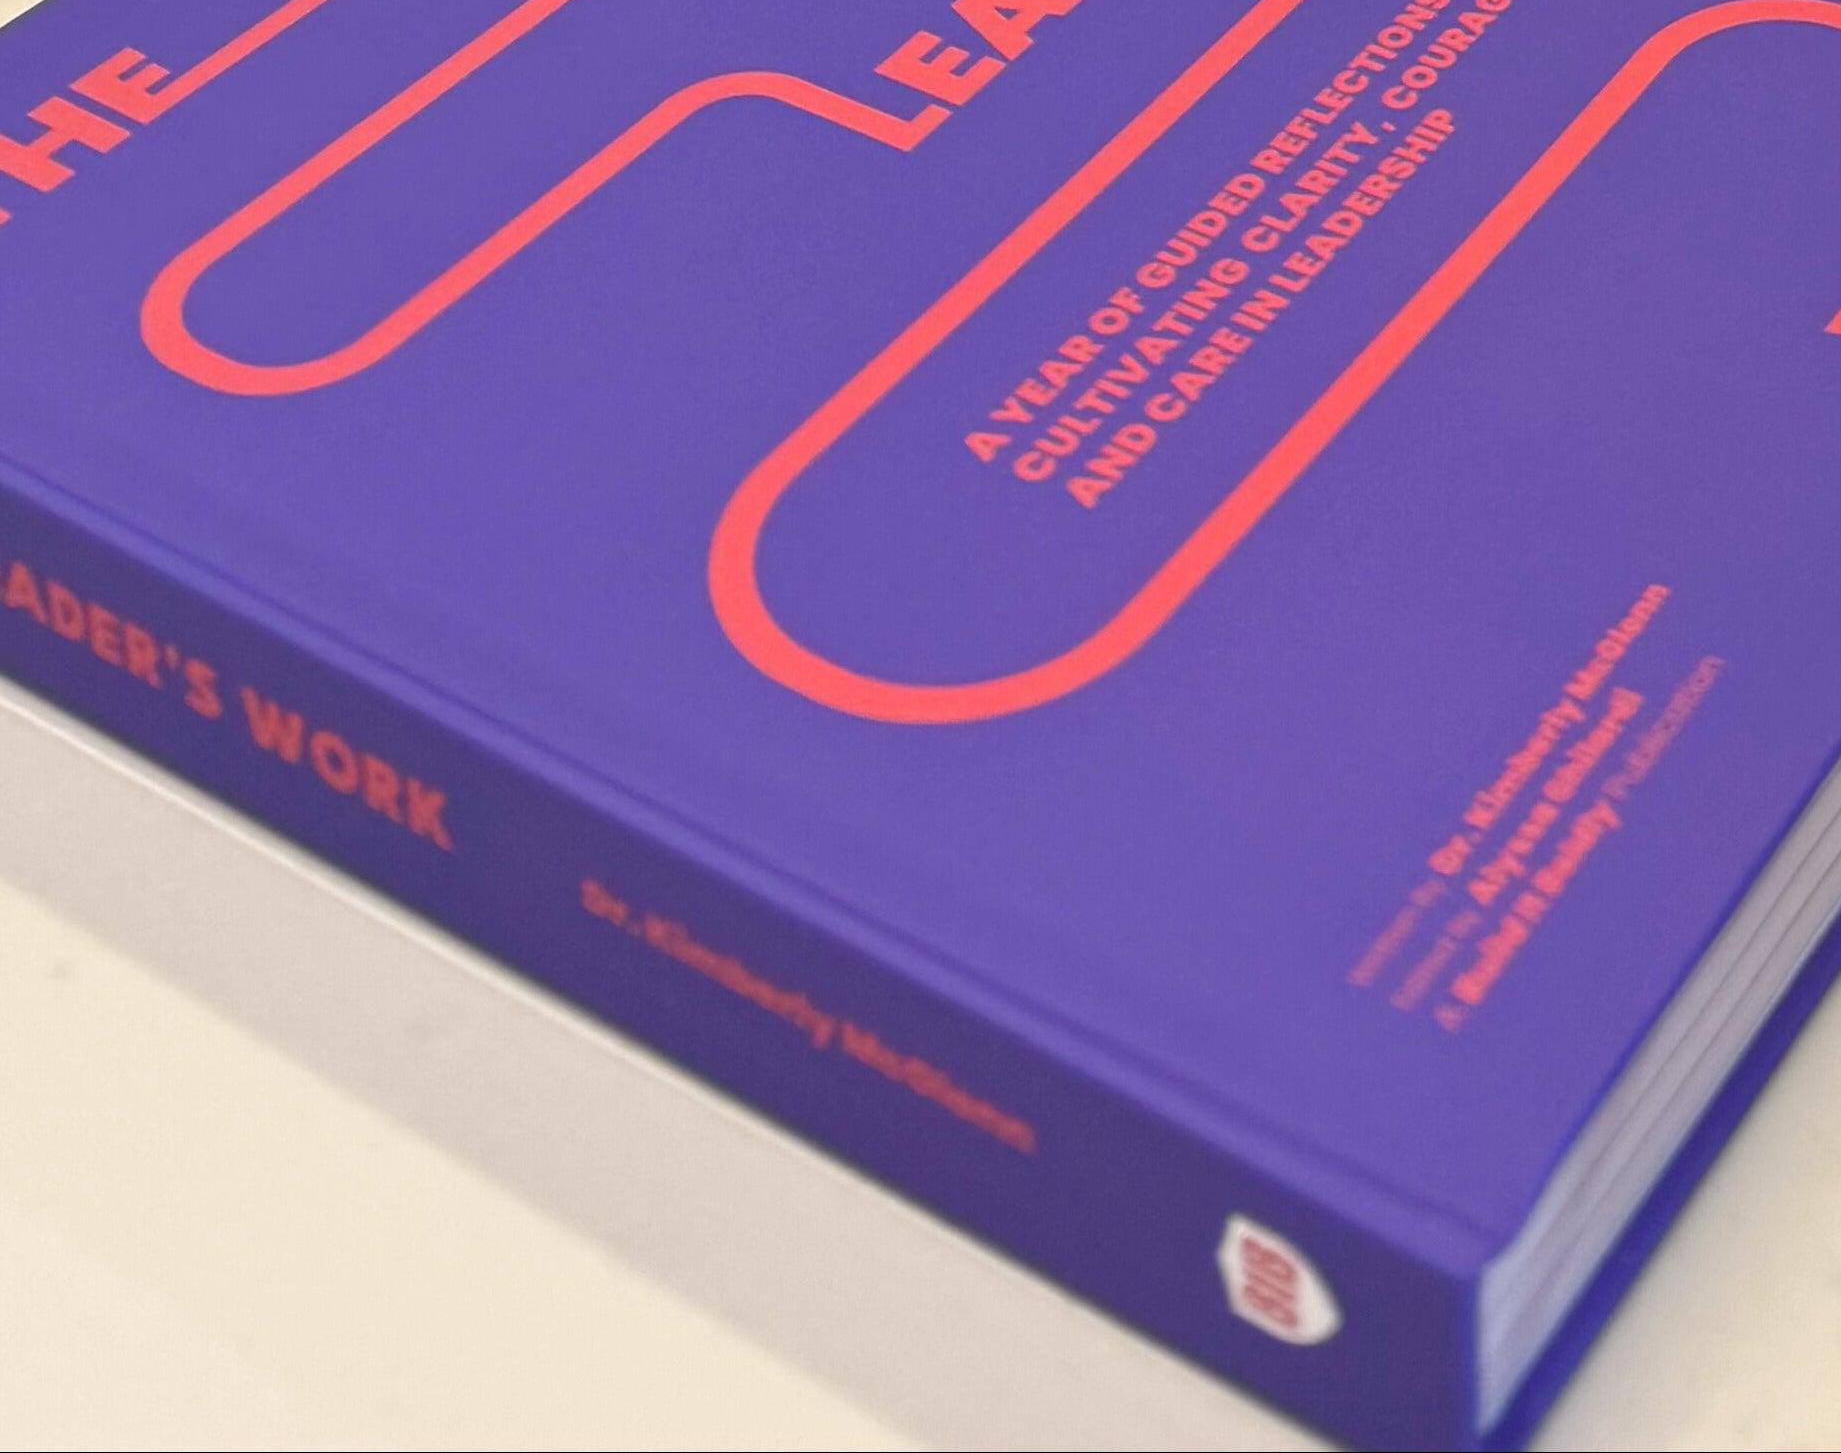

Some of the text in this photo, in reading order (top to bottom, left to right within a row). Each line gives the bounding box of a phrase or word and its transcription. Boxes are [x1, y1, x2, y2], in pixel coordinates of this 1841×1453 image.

[0, 47, 172, 225] HE
[963, 431, 1012, 464] A
[989, 334, 1105, 425] YEAR
[1087, 286, 1145, 337] OF
[1134, 172, 1267, 290] GUIDED
[1012, 257, 1250, 483] CULTIVATING
[1240, 120, 1397, 255] CLARITY,
[1065, 107, 1456, 510] AND CARE IN LEADERSHIP
[243, 686, 454, 852] WORK
[1463, 698, 1587, 830] Kimberly
[1240, 1236, 1299, 1330] BIB
